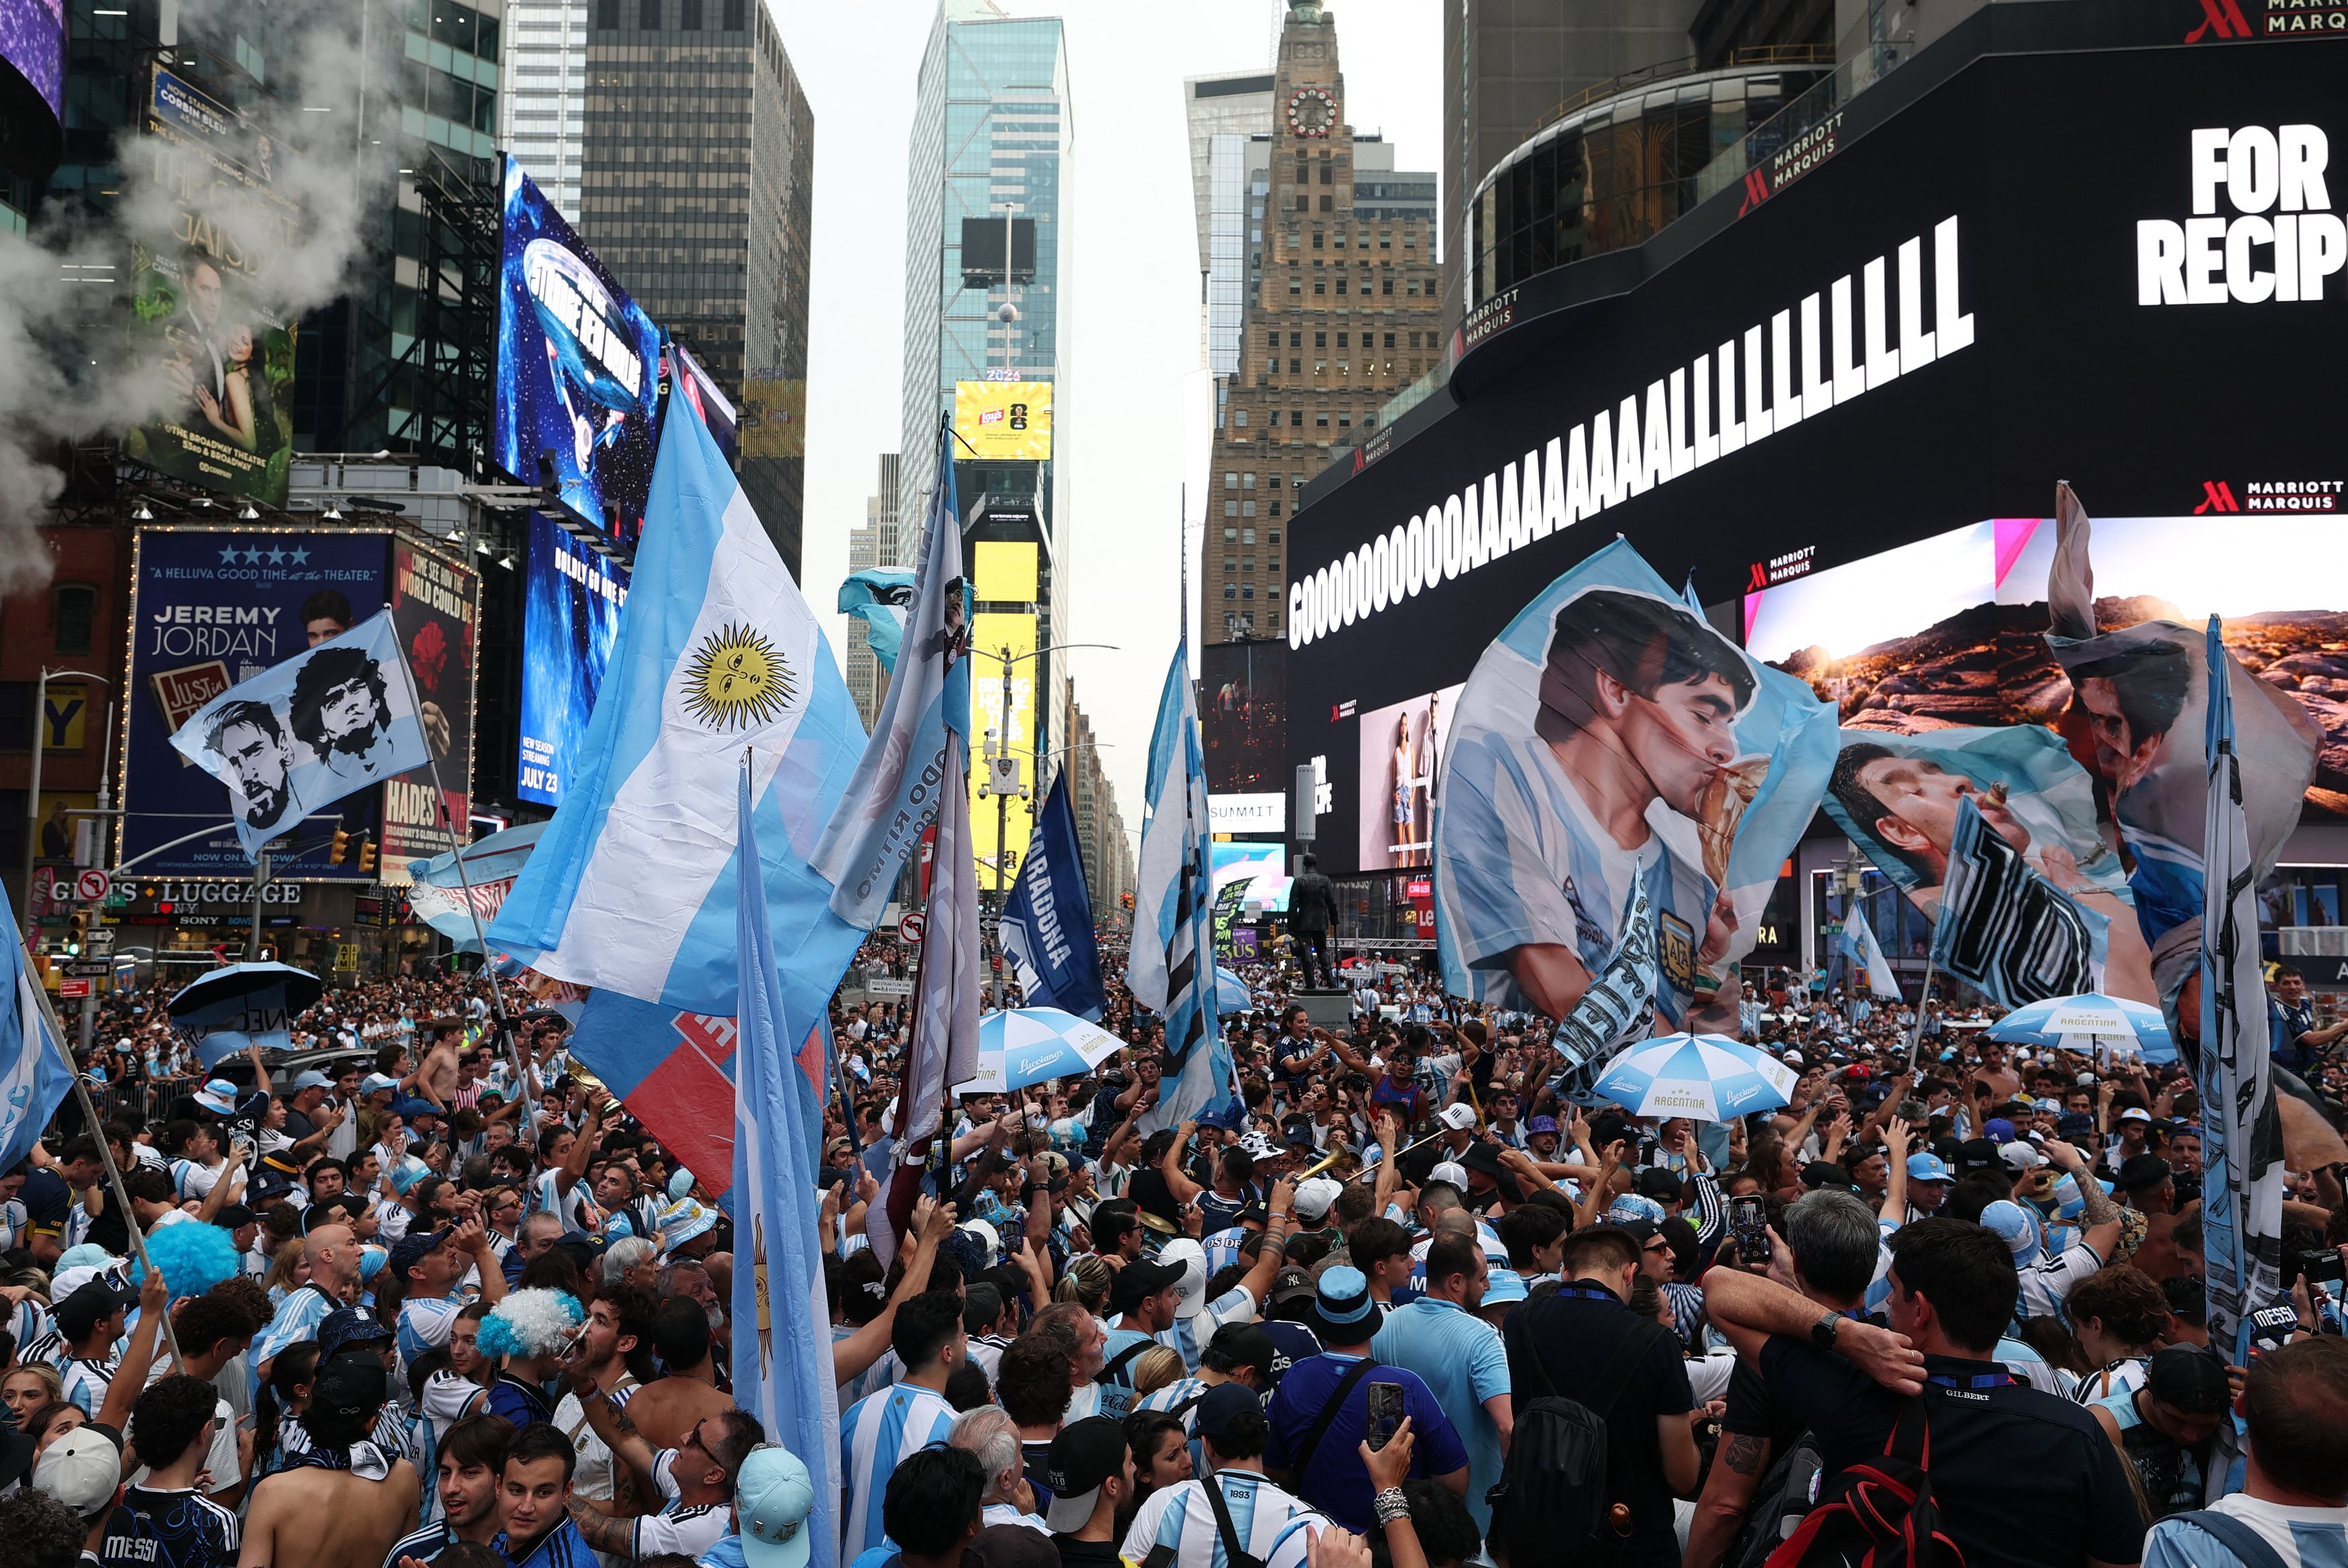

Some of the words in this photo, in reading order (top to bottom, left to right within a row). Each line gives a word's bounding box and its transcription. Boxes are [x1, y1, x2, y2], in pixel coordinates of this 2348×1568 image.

[166, 82, 186, 99] NOW
[160, 89, 200, 119] CORBIN
[202, 114, 227, 135] BLEU
[1774, 112, 1844, 170] MARRIOTT
[1774, 137, 1835, 188] MARQUIS
[2190, 124, 2331, 215] FOR
[2137, 213, 2347, 306] RECIP
[1466, 288, 1519, 330] MARRIOTT
[1466, 310, 1511, 347] MARQUIS
[189, 431, 233, 455] BROADWAY
[233, 448, 266, 468] THEATRE
[1366, 427, 1393, 452] MARRIOTT
[203, 449, 209, 457] &
[210, 451, 252, 471] BROADWAY
[1366, 441, 1389, 463] MARQUIS
[2247, 481, 2344, 494] MARRIOTT
[2247, 496, 2333, 510] MARQUIS
[1770, 545, 1815, 569] MARRIOTT
[166, 567, 215, 579] HELLUVA
[217, 569, 259, 580] GOOD
[262, 569, 288, 580] TIME
[411, 552, 428, 577] COME
[429, 561, 439, 583] SEE
[440, 567, 453, 590] HOW
[453, 573, 464, 595] THE
[554, 547, 588, 585] BOLDLY
[588, 569, 600, 594] GO
[601, 576, 617, 604] ONE
[1770, 561, 1810, 581] MARQUIS
[399, 567, 431, 604] WORLD
[432, 585, 461, 618] COULD
[461, 600, 473, 625] BE
[154, 605, 282, 625] JEREMY
[151, 626, 276, 657] JORDAN
[171, 677, 210, 708] JUST
[211, 681, 224, 695] in
[979, 693, 1028, 710] HOE
[1340, 699, 1357, 710] MARRIOTT
[1340, 708, 1355, 718] MARQUIS
[523, 736, 534, 749] NEW
[534, 740, 555, 755] SEASON
[522, 749, 549, 767] STREAMING
[521, 767, 545, 790] JULY
[545, 772, 557, 793] 23
[1315, 783, 1332, 816] CIPE
[385, 824, 419, 839] BROADWAY'S
[420, 829, 439, 842] GLOBAL
[193, 853, 221, 862] NOW
[223, 854, 239, 862] ON
[52, 881, 137, 901] GITS
[162, 883, 301, 903] LUGGAGE
[172, 903, 199, 913] NY
[180, 917, 219, 925] SONY
[340, 945, 348, 968] ATM
[2060, 1018, 2117, 1027] ARGENTINA
[1080, 1033, 1109, 1056] ARGENTINA
[1017, 1049, 1064, 1074] Lucciano's
[1654, 1095, 1705, 1109] ARGENTINA
[1725, 1083, 1762, 1107] Lucciano's
[227, 1119, 255, 1139] MSSI
[1287, 1274, 1300, 1286] NY
[2254, 1305, 2298, 1327] MESSI
[1945, 1389, 1990, 1401] GILBERT
[1230, 1490, 1250, 1500] 1893
[105, 1535, 158, 1563] MESSI
